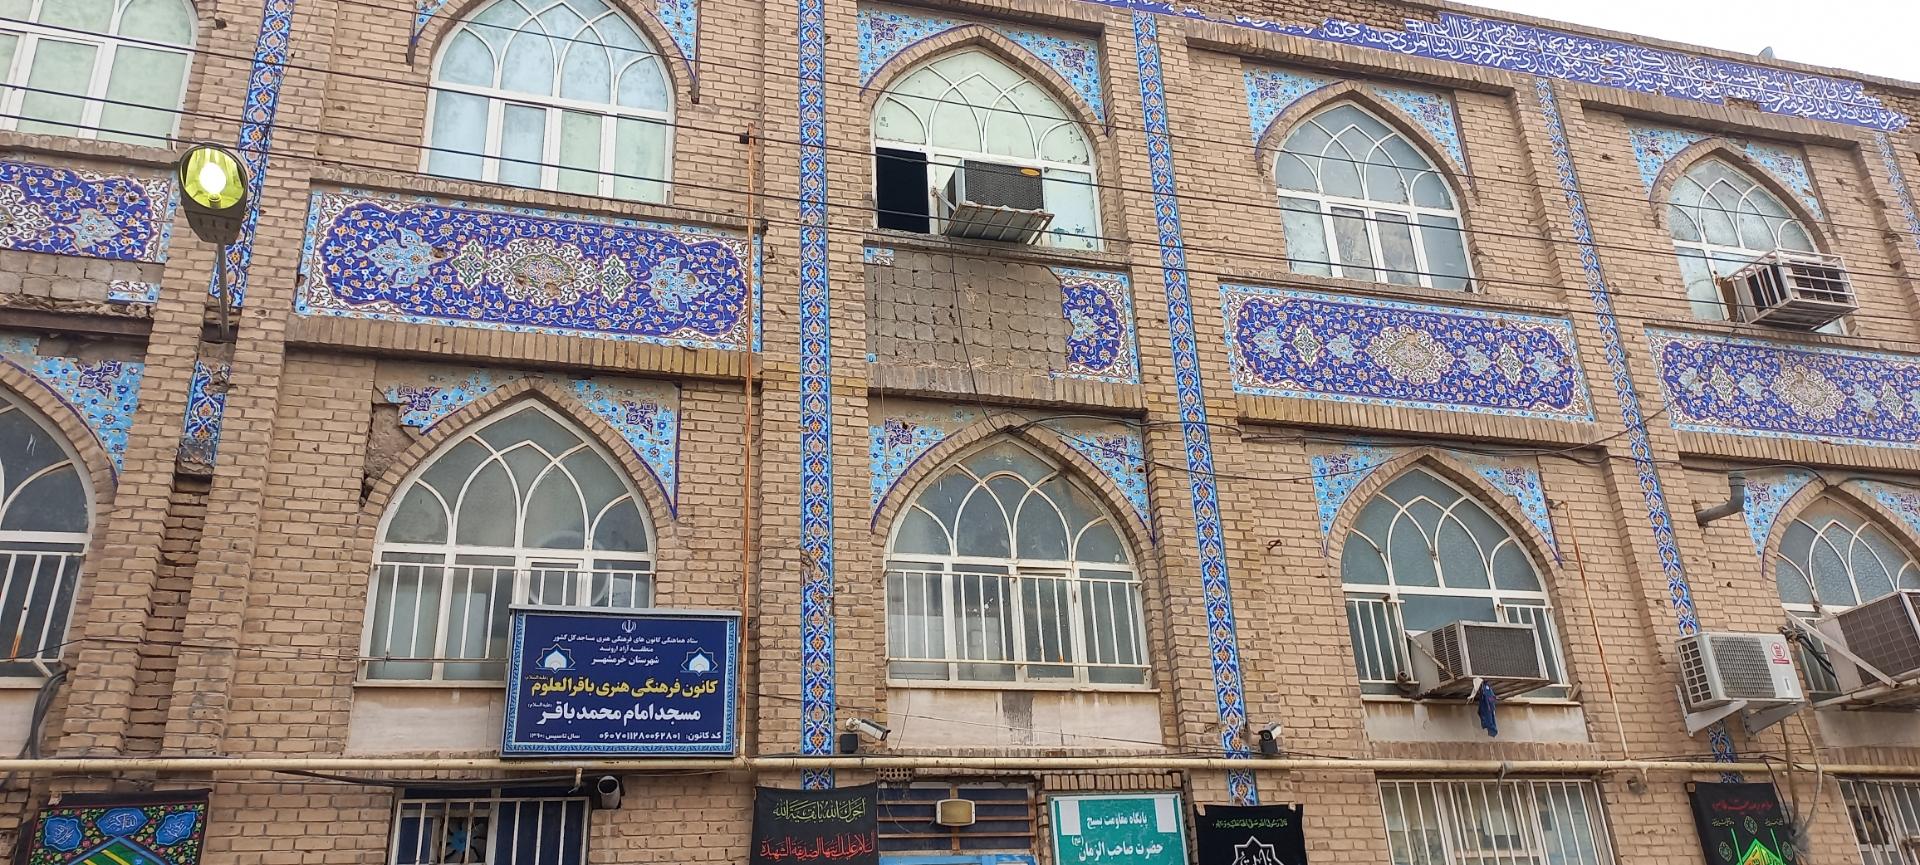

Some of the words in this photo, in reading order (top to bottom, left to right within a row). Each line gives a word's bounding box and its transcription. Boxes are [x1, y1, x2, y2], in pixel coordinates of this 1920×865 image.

[552, 633, 568, 643] کشور
[596, 634, 610, 643] هنری
[611, 633, 633, 645] فرهنگی
[633, 634, 645, 644] های
[645, 635, 661, 645] کانون
[661, 636, 686, 645] هماهنگی
[591, 655, 626, 666] خرمشهر
[629, 654, 660, 666] شهرستان
[595, 681, 630, 698] هنری
[631, 677, 681, 699] فرهنگی
[682, 679, 719, 699] کانون
[536, 700, 576, 725] باقر
[576, 706, 622, 720] محمد
[623, 703, 654, 727] امام
[654, 706, 701, 725] مسجد
[710, 731, 722, 740] کد
[1086, 816, 1103, 829] بسیج
[1104, 813, 1128, 829] مقاومت
[1129, 811, 1148, 828] پایگاه
[1078, 842, 1106, 861] الزمان
[1106, 841, 1134, 858] صاحب
[1135, 840, 1164, 859] حضرت
